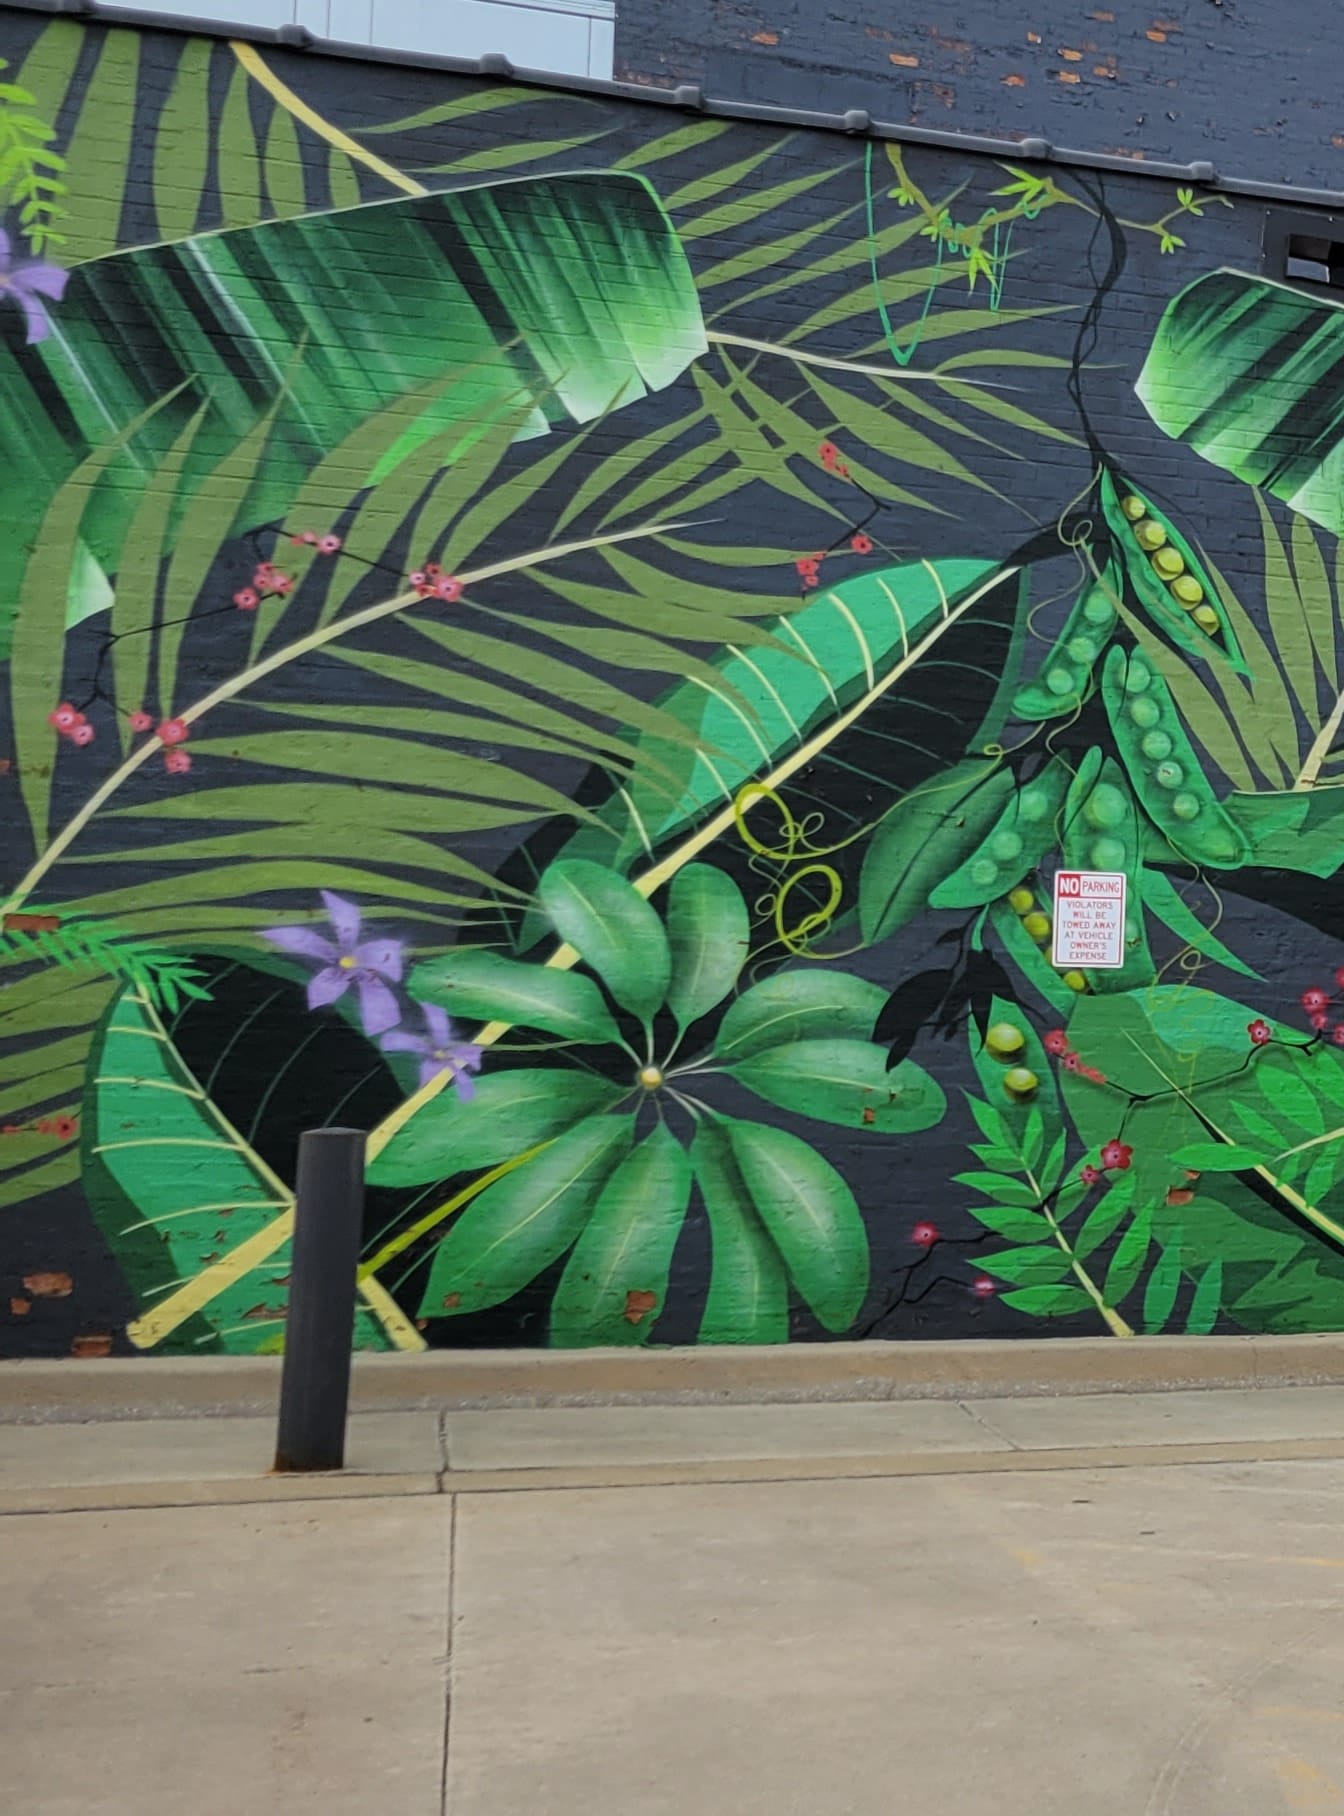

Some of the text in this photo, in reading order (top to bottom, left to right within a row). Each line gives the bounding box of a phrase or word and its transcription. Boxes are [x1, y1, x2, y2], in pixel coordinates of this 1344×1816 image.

[1060, 878, 1120, 894] NO PARKING
[1067, 901, 1113, 910] VIOLATORS
[1073, 911, 1106, 920] WILL BE
[1063, 921, 1117, 929] TOWED AWAY
[1064, 931, 1113, 940] AT VEHICLE
[1070, 941, 1107, 950] OWNER'S
[1069, 951, 1107, 960] EXPENSE
